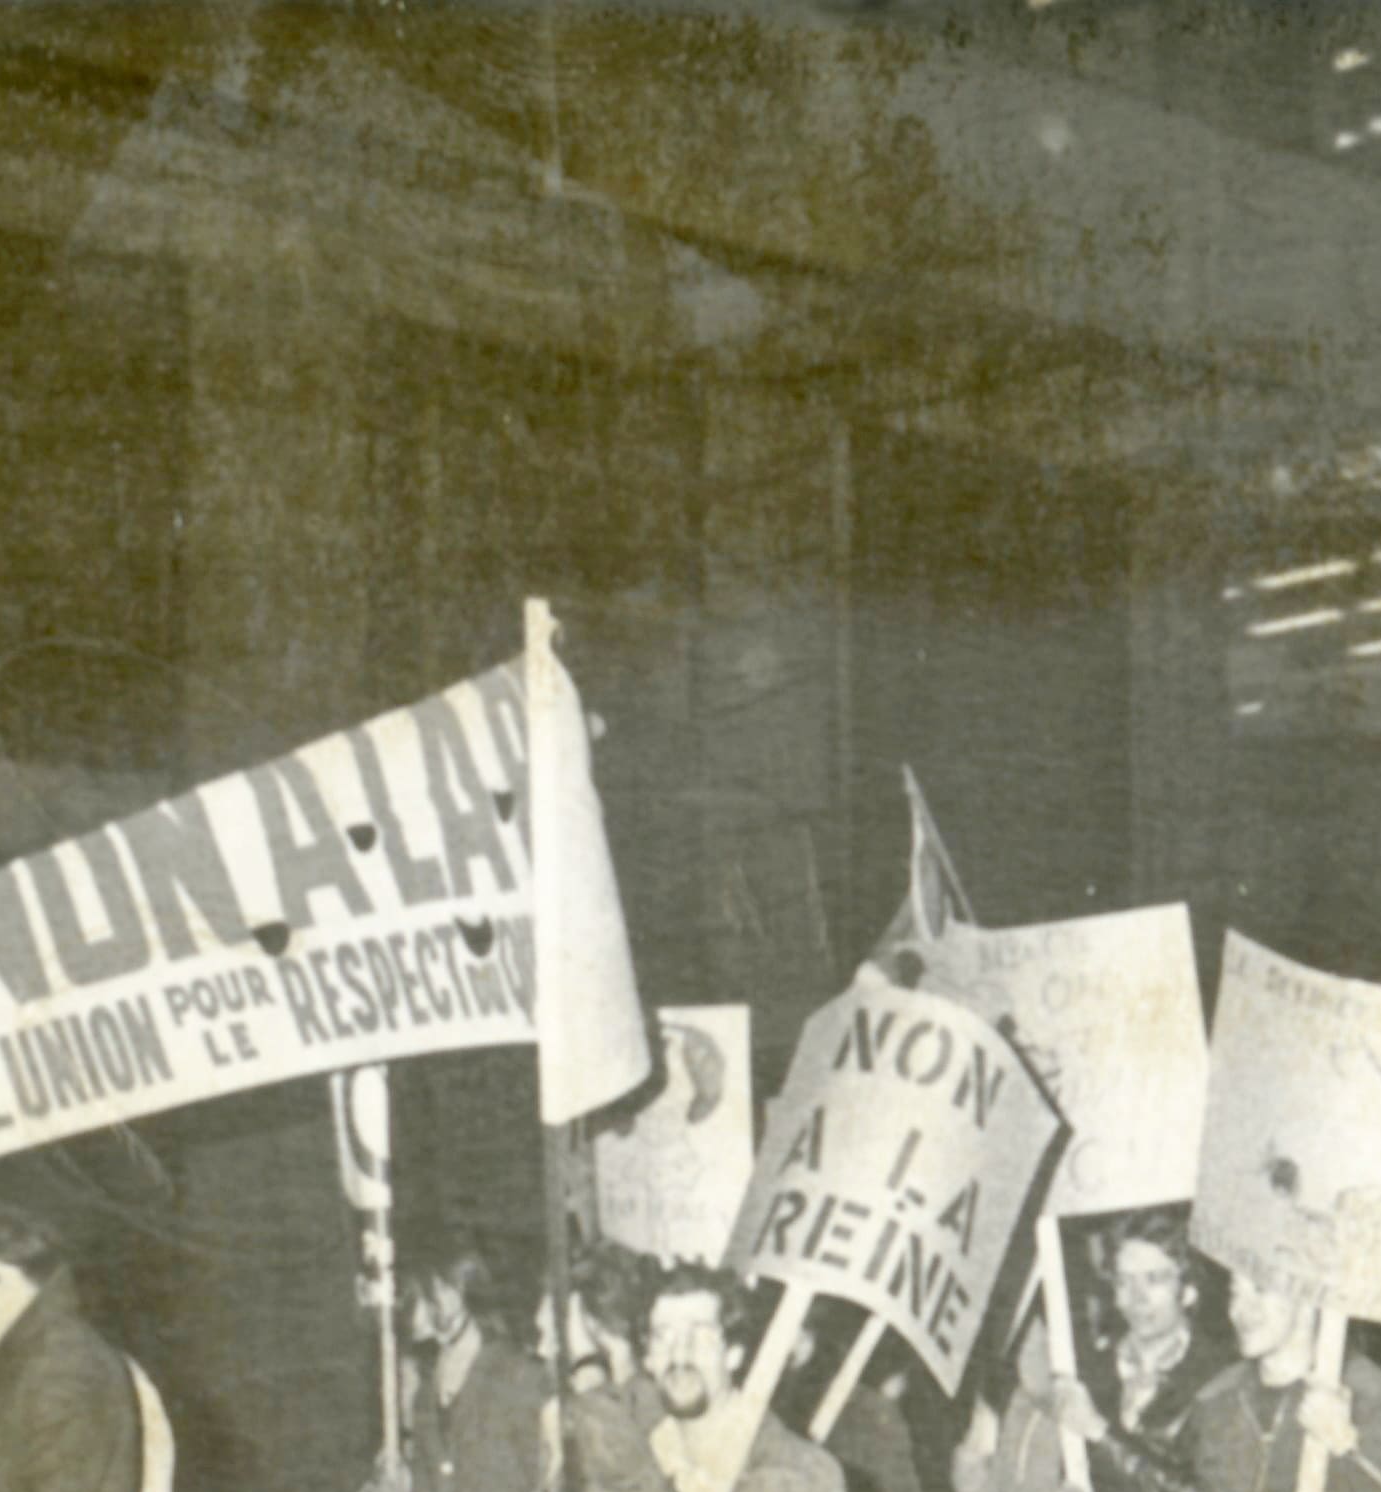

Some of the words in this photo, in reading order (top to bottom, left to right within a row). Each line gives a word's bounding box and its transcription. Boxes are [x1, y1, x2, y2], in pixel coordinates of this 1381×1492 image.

[347, 697, 520, 908] LA
[164, 966, 276, 1028] POUR
[280, 925, 464, 1044] RESPECT
[203, 1022, 259, 1067] LE
[831, 1006, 1004, 1132] NON
[776, 1106, 826, 1174] A
[752, 1190, 971, 1356] REINE
